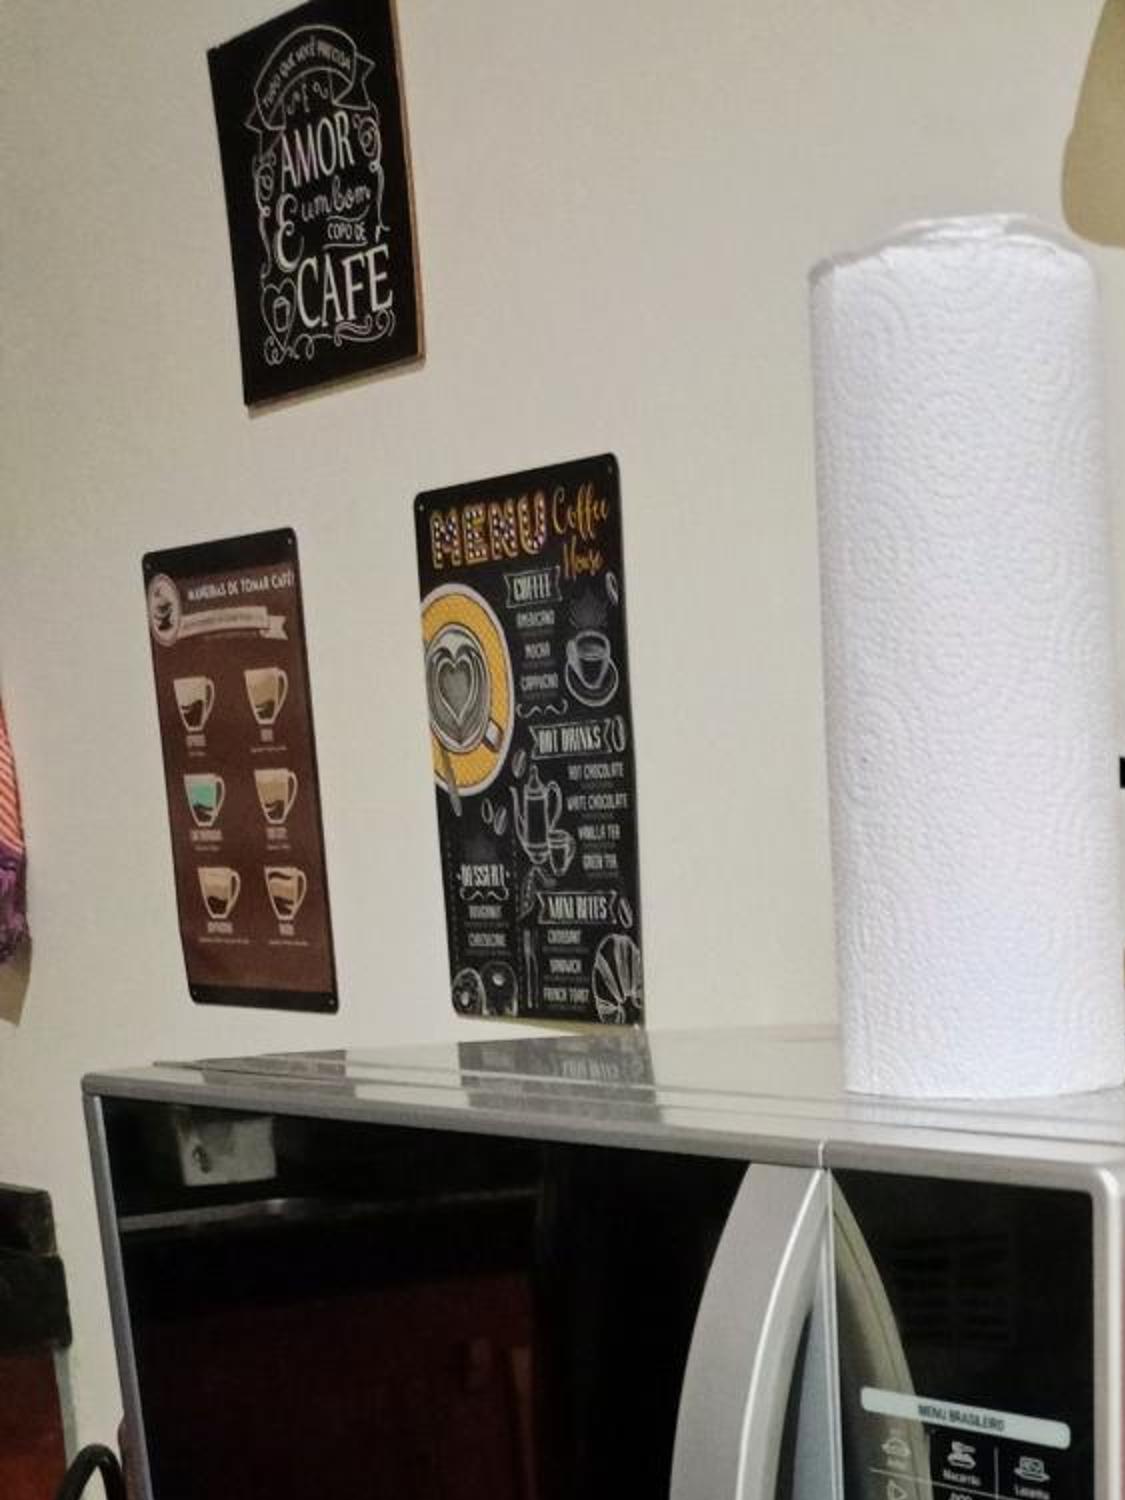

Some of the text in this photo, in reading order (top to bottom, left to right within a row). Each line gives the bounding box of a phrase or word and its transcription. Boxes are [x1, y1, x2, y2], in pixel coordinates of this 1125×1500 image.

[280, 109, 355, 193] AMOR
[552, 482, 608, 542] Coffee
[430, 491, 548, 569] MENU
[241, 574, 270, 593] TOMAR
[512, 573, 551, 602] COFFEE
[561, 725, 602, 753] DRINKS
[918, 1403, 1006, 1432] MENU BRASILEIRO
